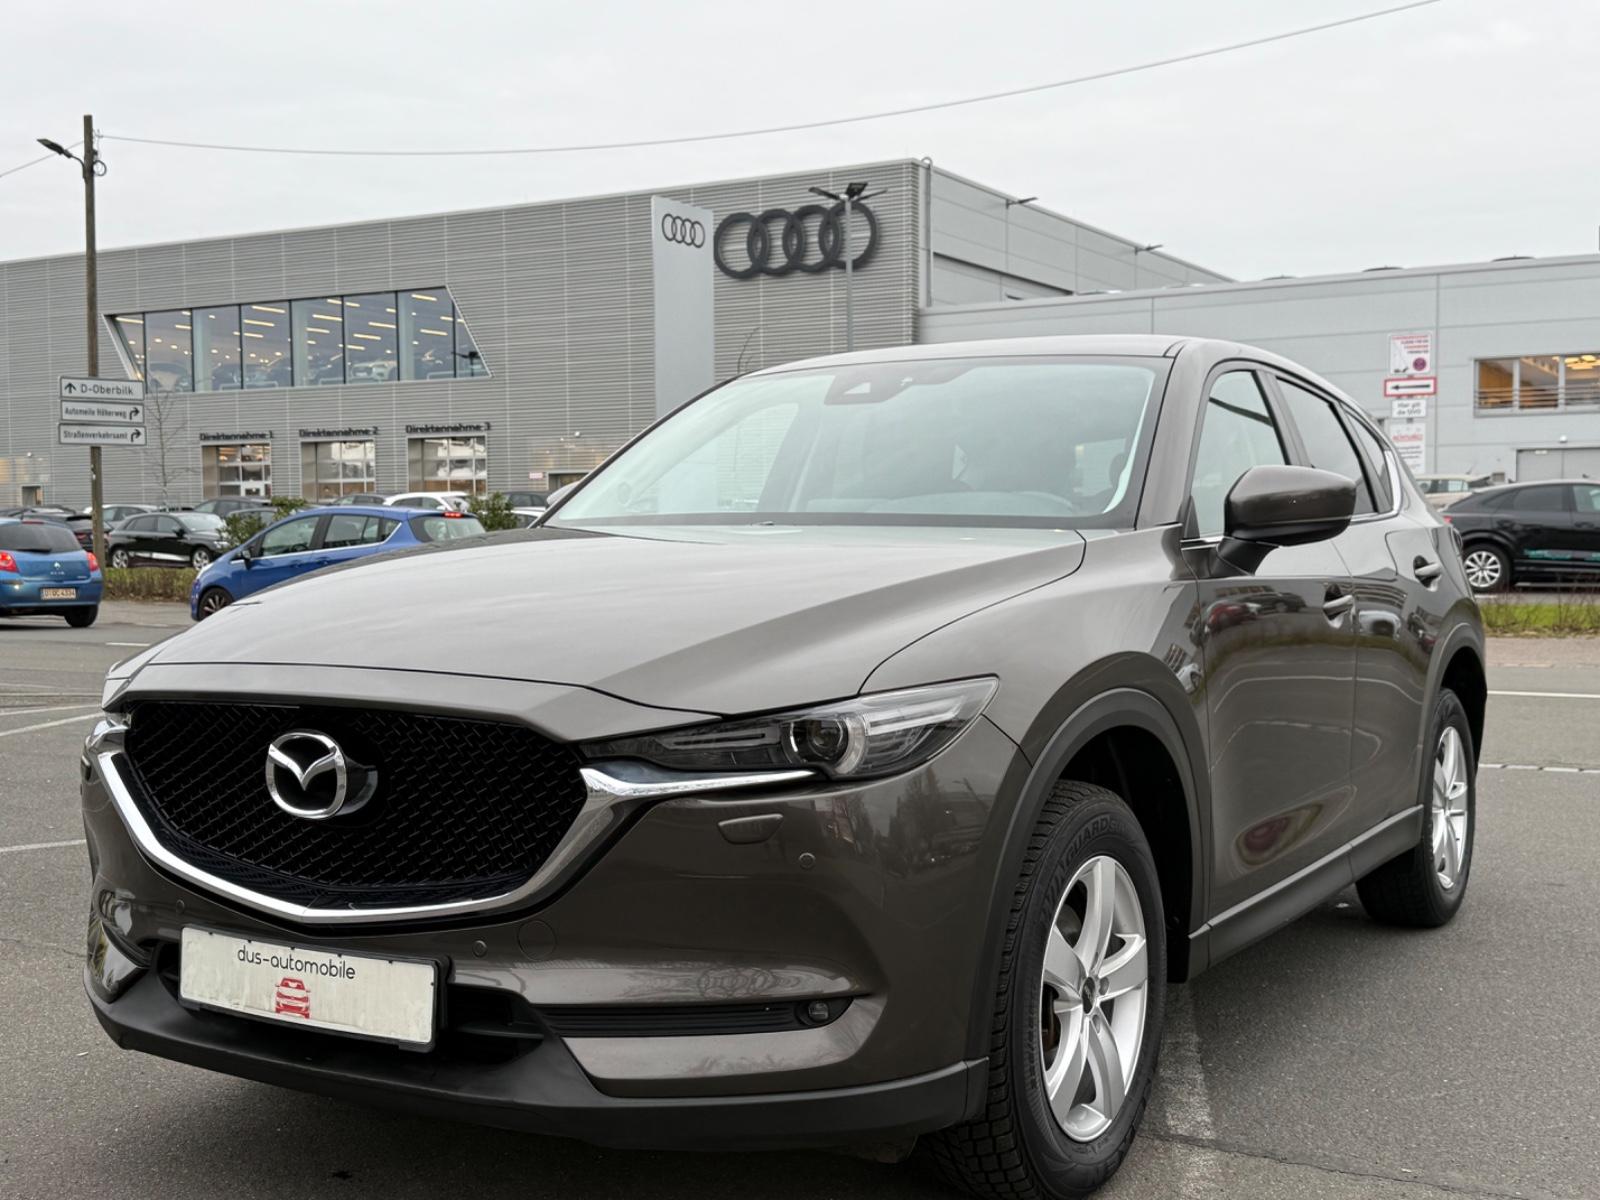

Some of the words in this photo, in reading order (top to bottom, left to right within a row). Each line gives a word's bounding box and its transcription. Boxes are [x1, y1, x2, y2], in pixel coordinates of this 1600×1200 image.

[80, 383, 134, 395] D-Oberbilk
[64, 407, 96, 417] Automeile
[484, 421, 491, 430] 3
[63, 430, 128, 440] Straßenverkehrsamt
[237, 945, 356, 980] dus-automobile
